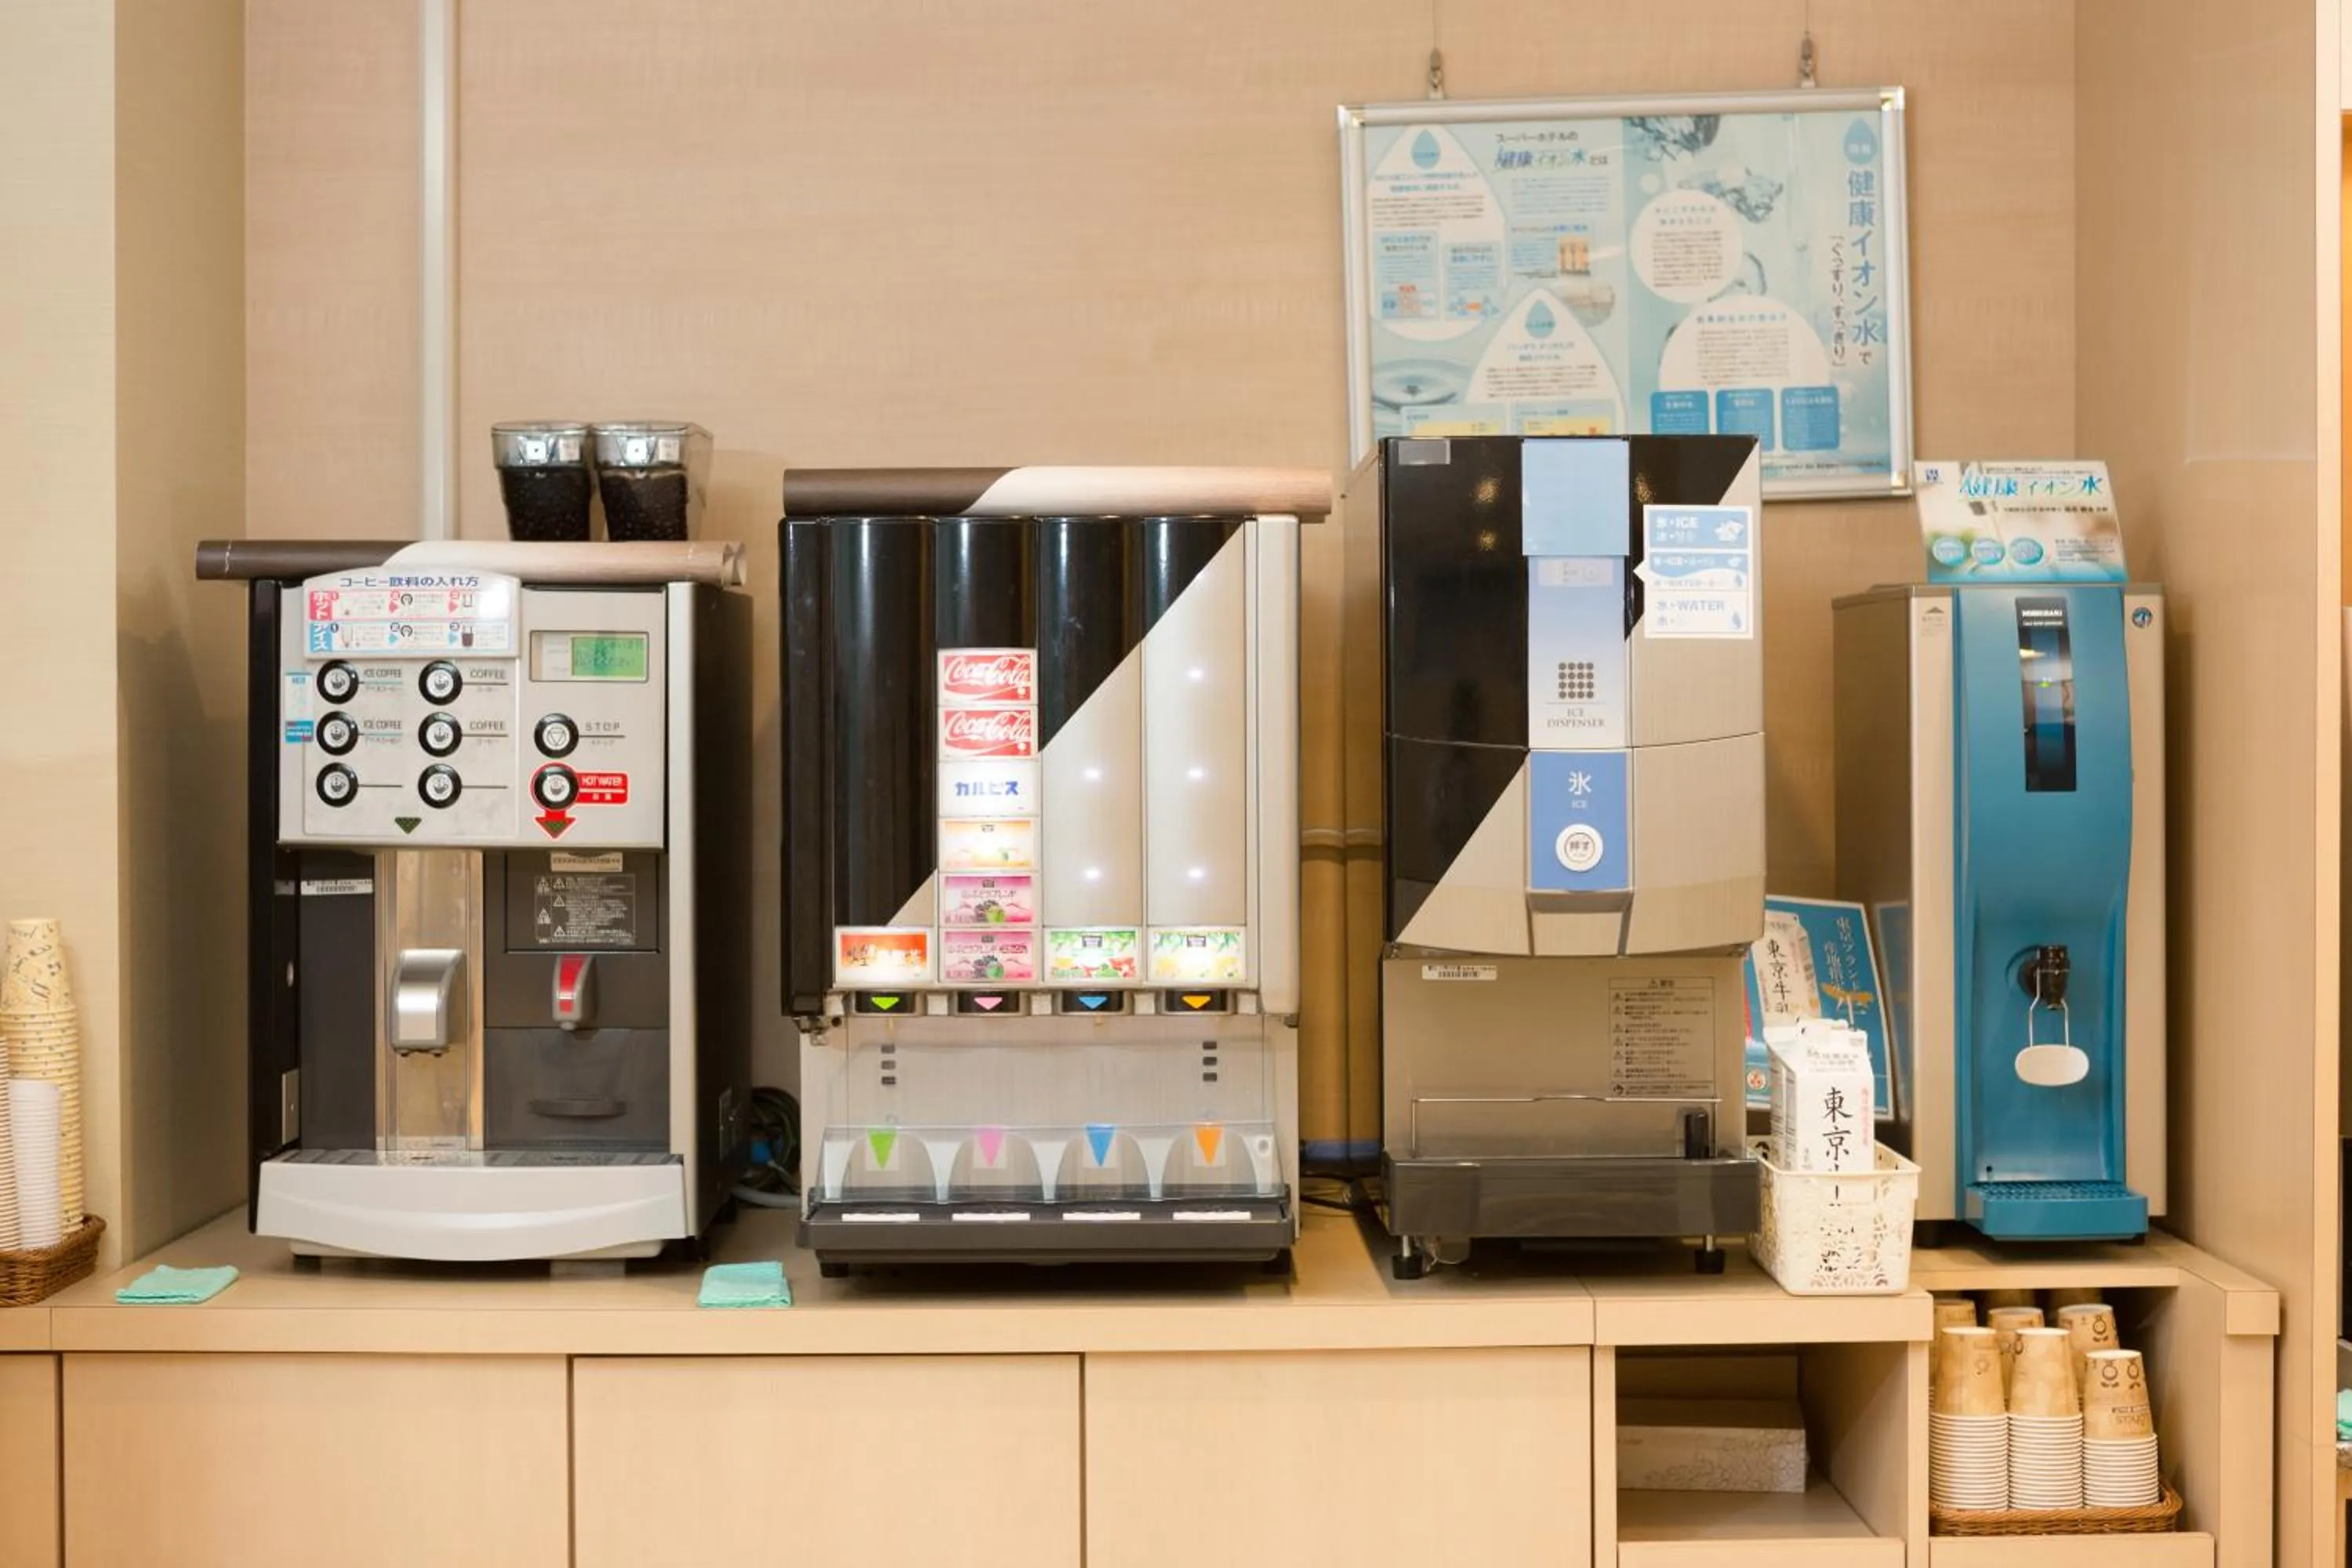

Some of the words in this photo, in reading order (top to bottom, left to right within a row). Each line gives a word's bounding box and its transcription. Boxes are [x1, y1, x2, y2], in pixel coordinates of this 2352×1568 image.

[1494, 131, 1579, 143] スーパーホテルの
[1848, 169, 1878, 366] 健康イオン水で
[339, 576, 480, 587] コーヒー飲料の入れ方
[313, 590, 330, 620] ホット
[470, 670, 506, 679] COFFEE
[470, 721, 505, 730] COFFEE
[585, 722, 620, 731] STOP
[1547, 719, 1606, 728] DISPENSER
[582, 777, 596, 786] HOT
[1568, 771, 1592, 795] 氷
[956, 781, 1018, 797] カルピス
[1572, 800, 1588, 809] ICE
[1822, 1086, 1853, 1171] 東京
